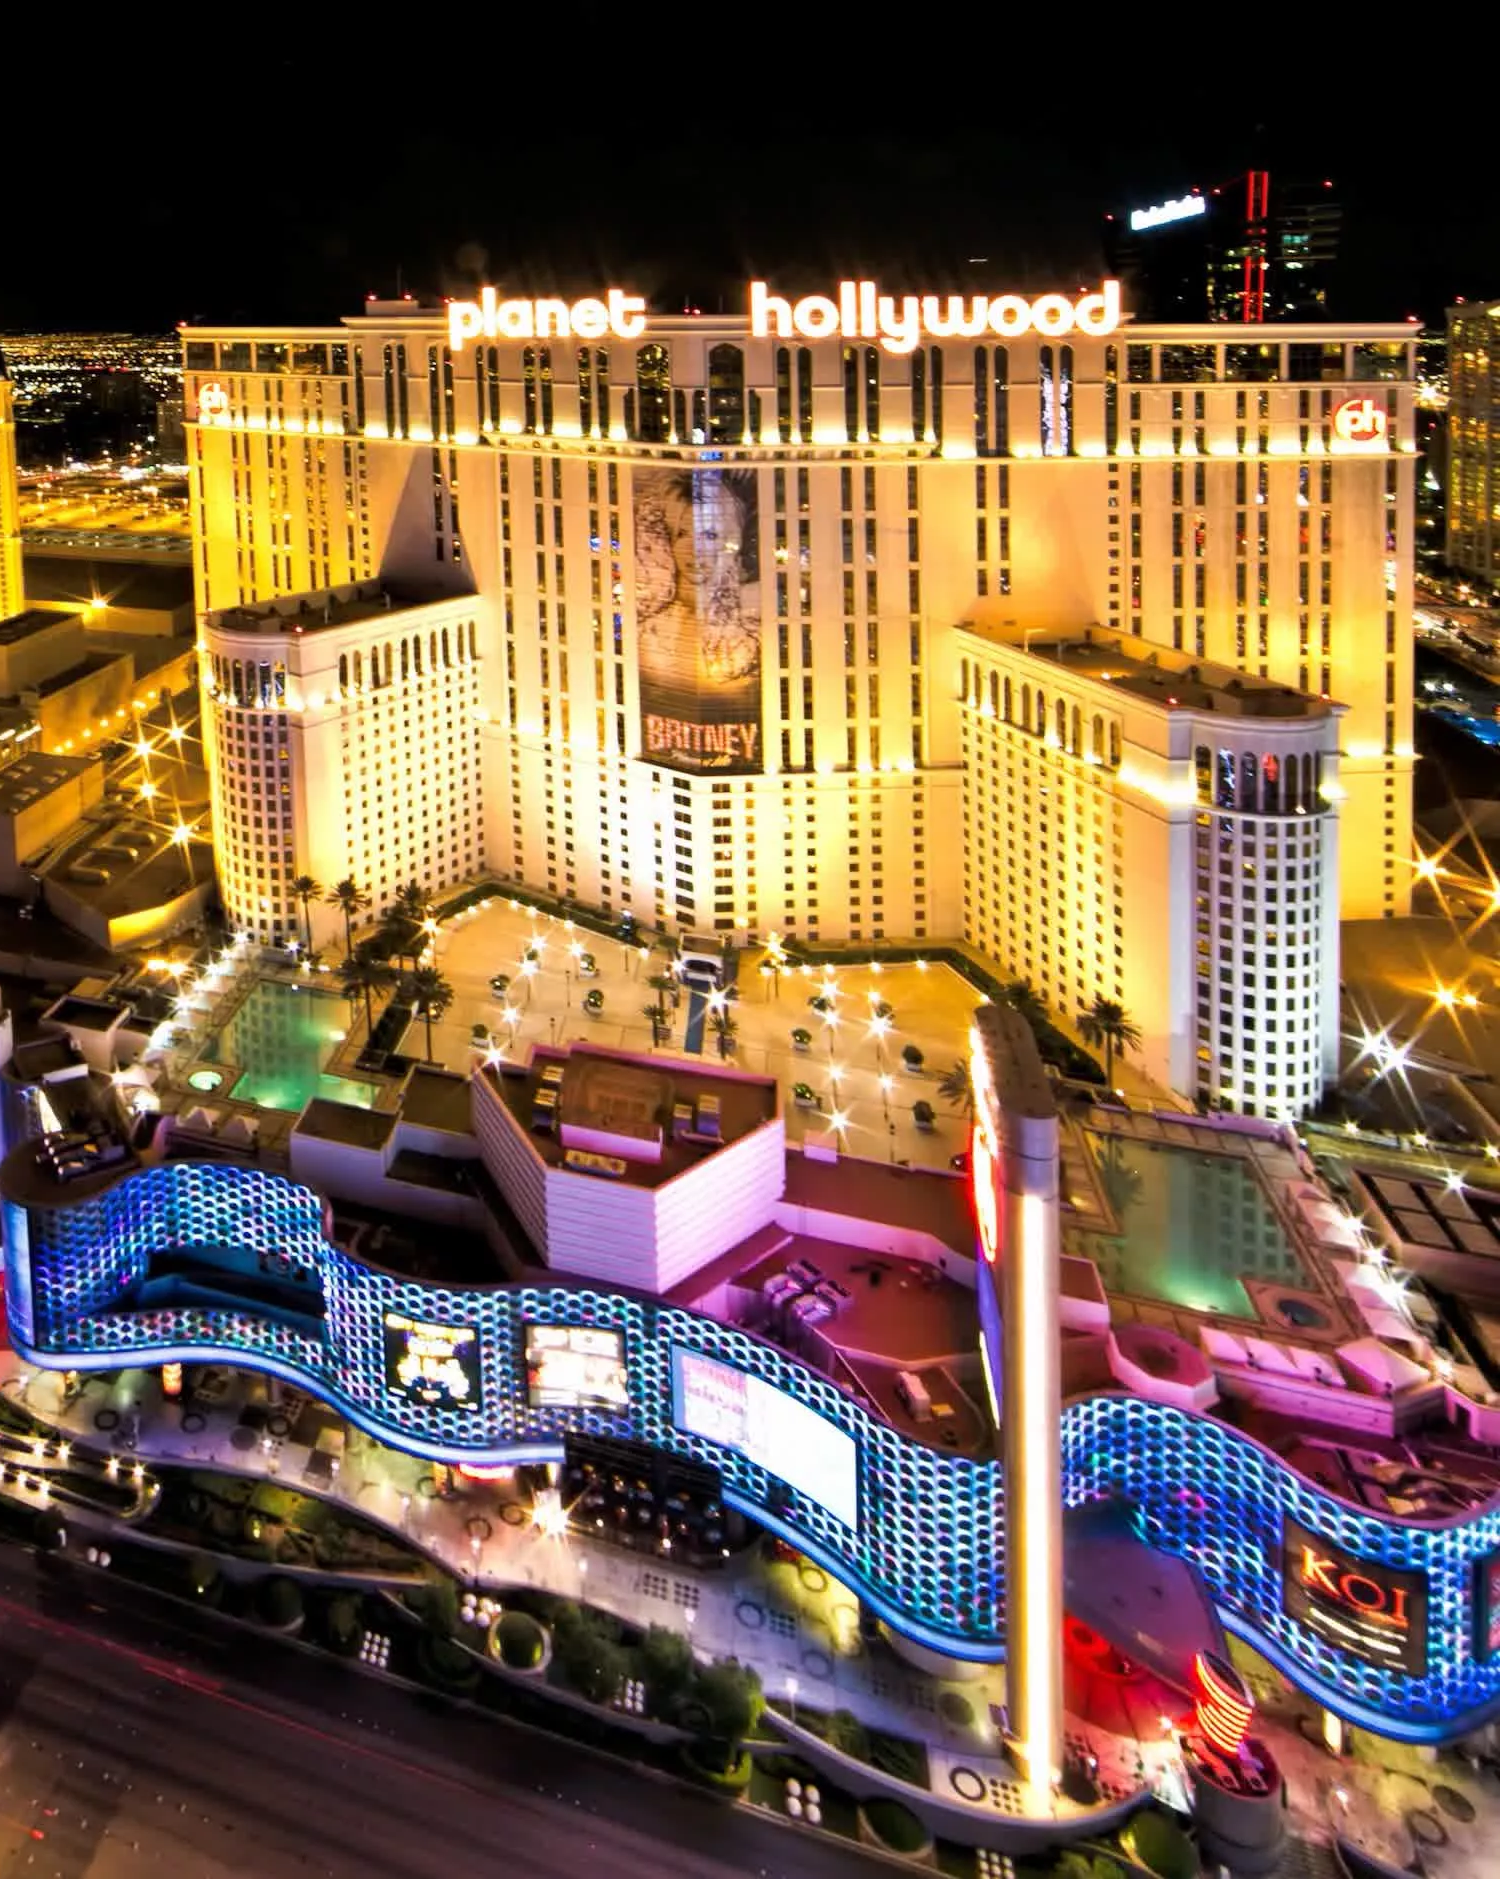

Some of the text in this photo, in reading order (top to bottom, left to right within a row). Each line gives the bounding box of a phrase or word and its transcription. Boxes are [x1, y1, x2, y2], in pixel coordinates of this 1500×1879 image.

[448, 280, 1120, 353] planet hollywood
[1346, 399, 1387, 438] ph
[646, 714, 758, 759] BRITNEY
[1301, 1544, 1409, 1629] KOI
